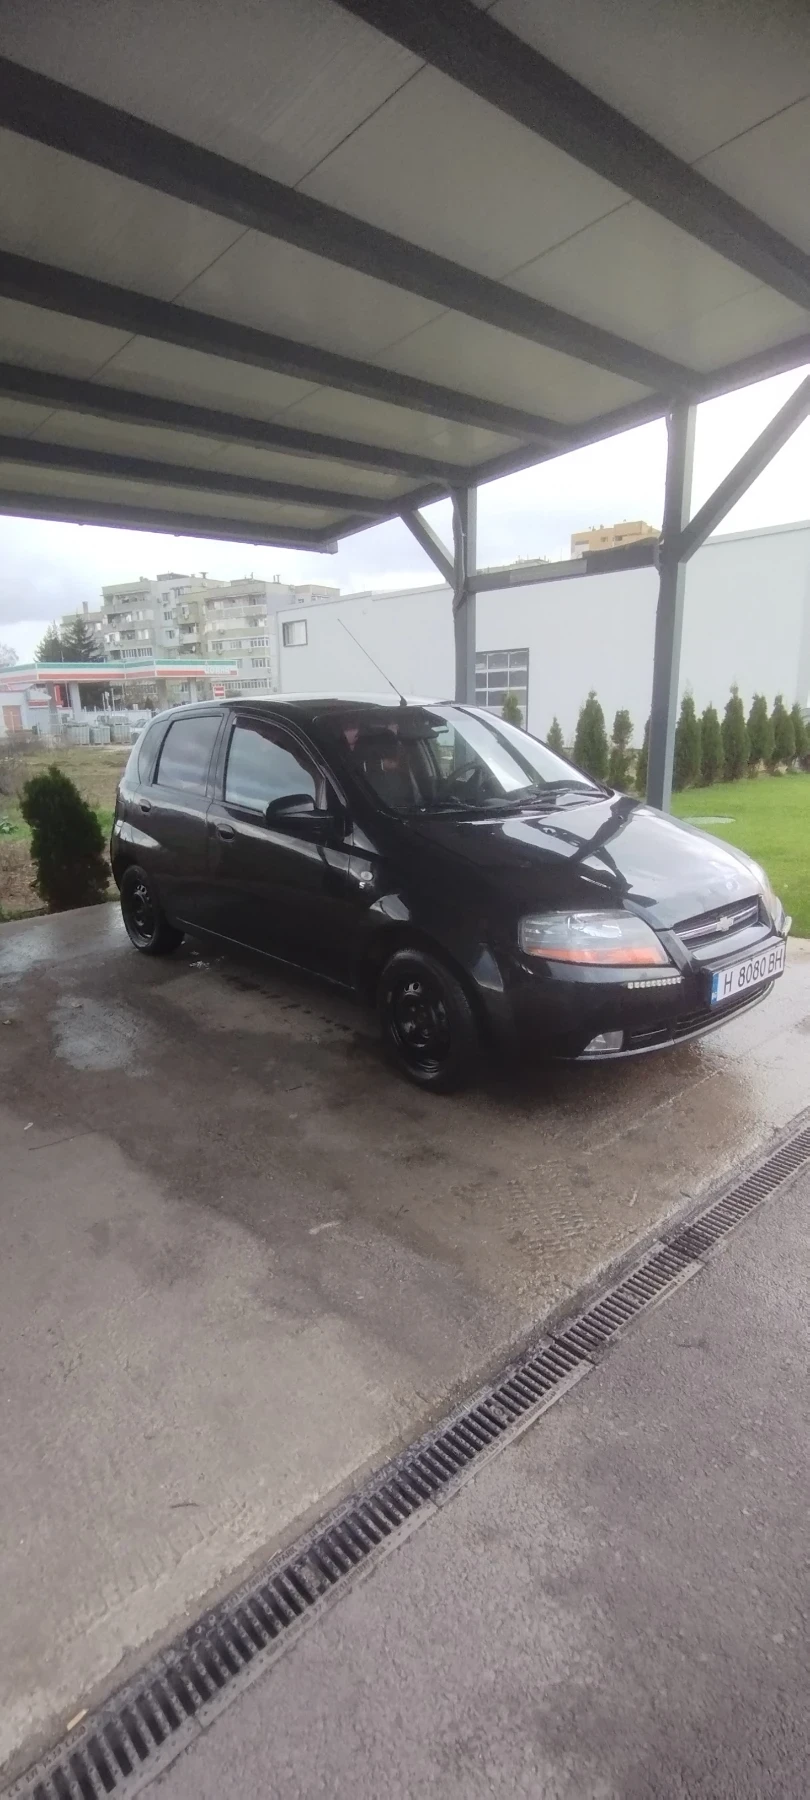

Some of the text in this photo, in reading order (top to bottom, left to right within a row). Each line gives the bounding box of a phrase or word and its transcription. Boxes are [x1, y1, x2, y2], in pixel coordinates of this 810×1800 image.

[723, 948, 783, 995] H 8080 BH
